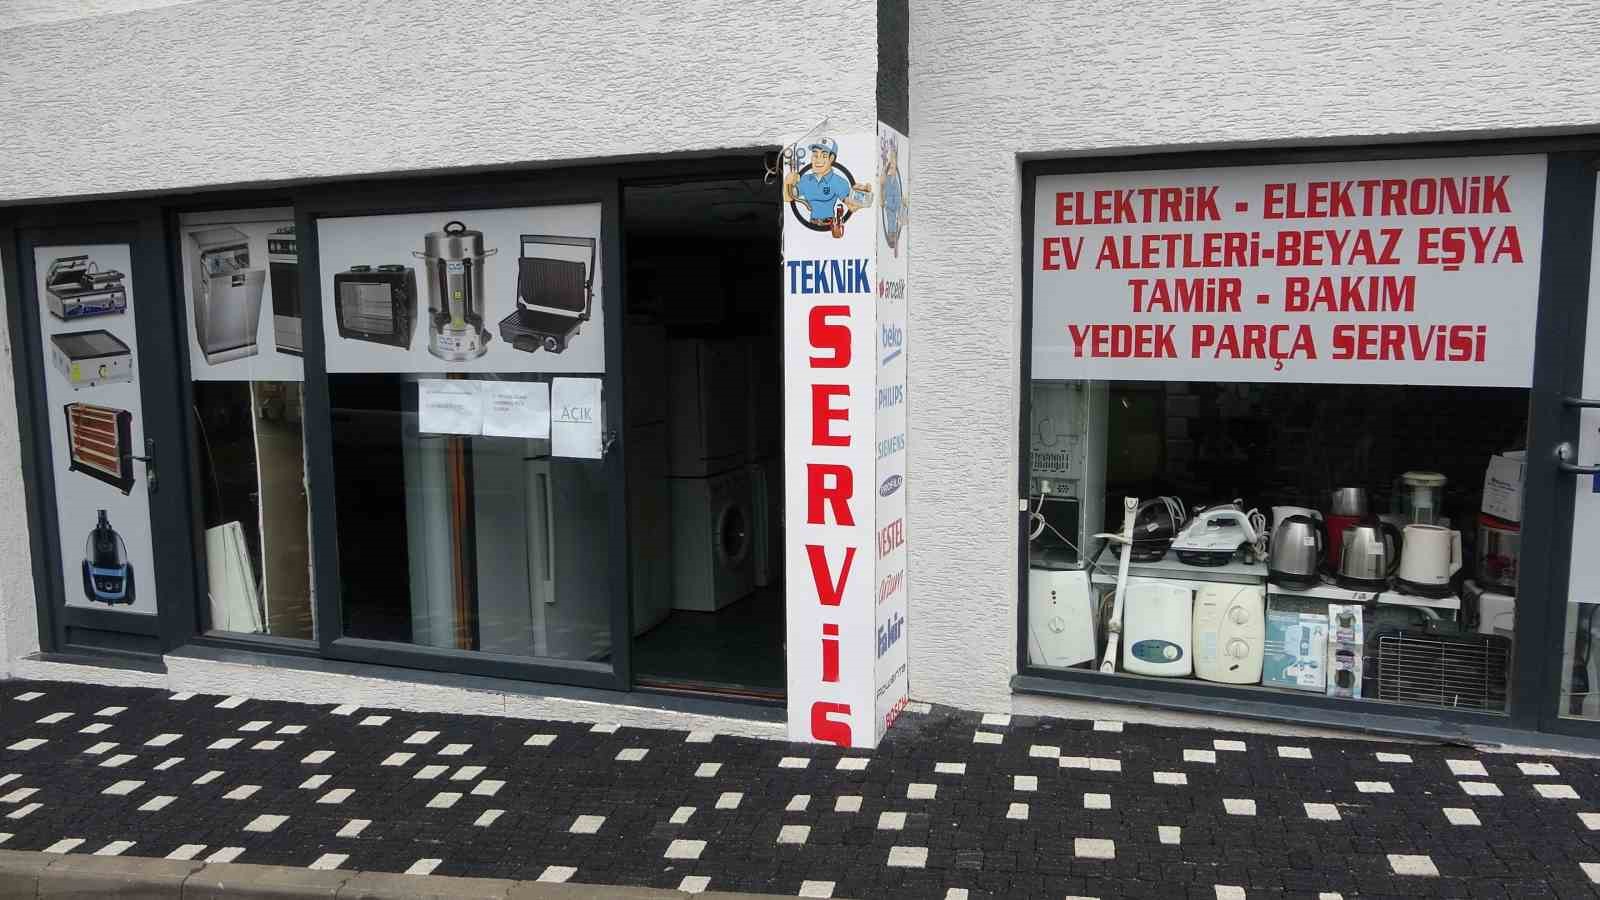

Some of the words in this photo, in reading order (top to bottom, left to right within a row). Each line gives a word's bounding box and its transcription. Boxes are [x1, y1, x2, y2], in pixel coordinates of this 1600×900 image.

[1041, 236, 1085, 271] EV
[1417, 225, 1524, 272] EŞYA
[1284, 275, 1417, 313] BAKIM
[1067, 323, 1178, 359] YEDEK
[1191, 323, 1317, 371] PARÇA
[878, 384, 904, 410] PHILIPS
[878, 432, 905, 460] SIEMENS
[877, 517, 905, 561] VESTEL
